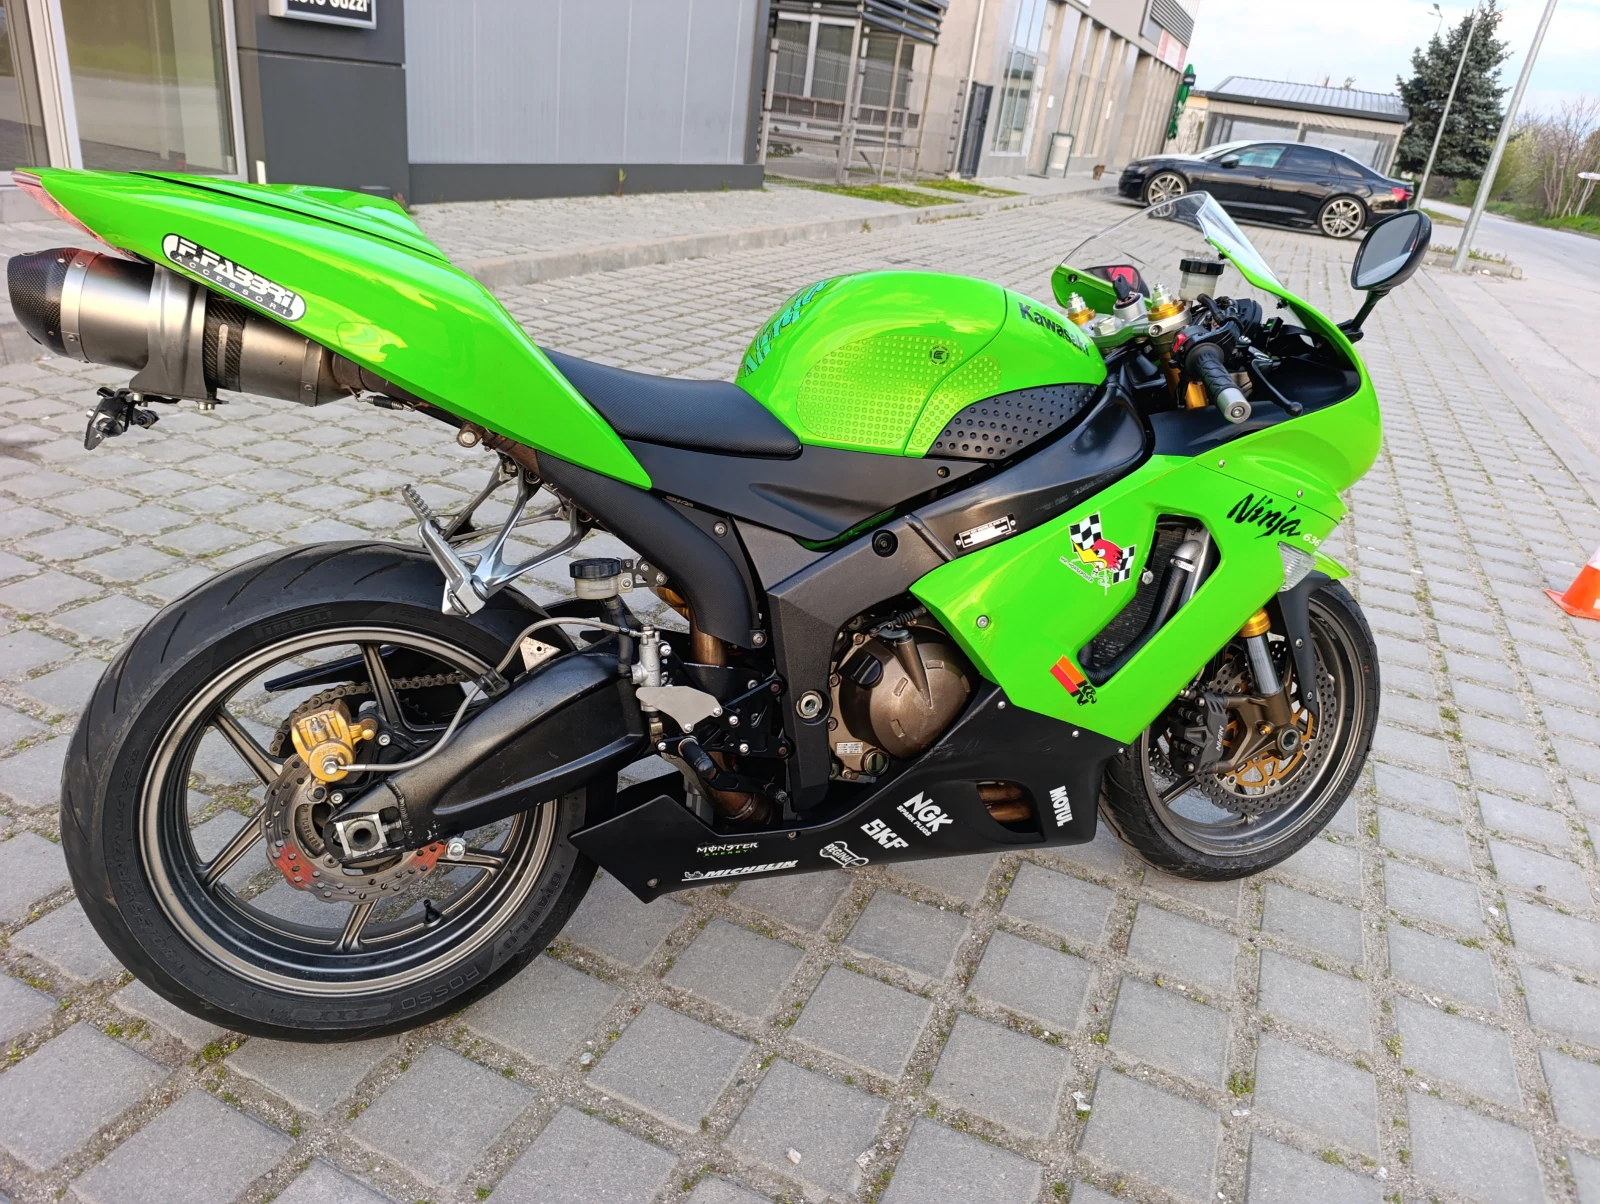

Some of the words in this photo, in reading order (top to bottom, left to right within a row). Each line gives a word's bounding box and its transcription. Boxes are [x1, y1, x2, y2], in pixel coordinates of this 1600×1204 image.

[176, 256, 288, 315] ACCESSORI
[1018, 302, 1090, 357] Kawasaki
[1226, 493, 1301, 539] Ninja
[1303, 533, 1321, 547] 636
[896, 805, 915, 823] SPARK
[913, 821, 932, 837] PLUGS
[902, 791, 954, 833] NGK
[1049, 785, 1073, 827] MOTUL
[696, 842, 760, 853] MONSTER
[823, 842, 853, 864] REGINA
[860, 818, 909, 849] SKF
[704, 860, 799, 878] MICHELIN
[500, 872, 565, 950] DIABLO
[399, 966, 481, 1010] ROSSO
